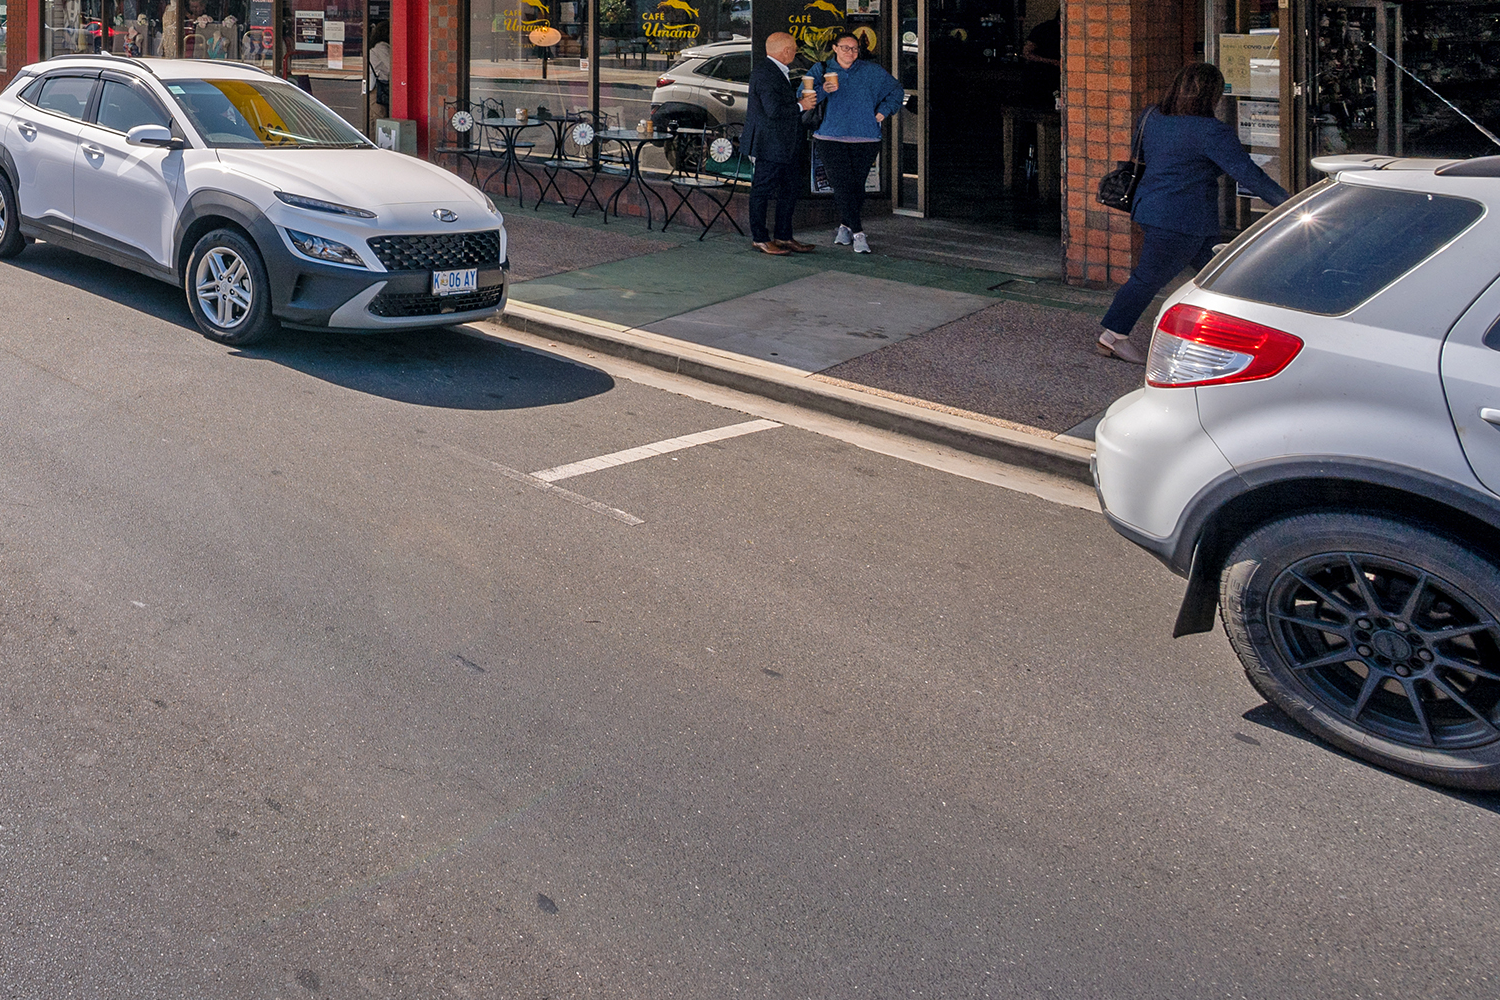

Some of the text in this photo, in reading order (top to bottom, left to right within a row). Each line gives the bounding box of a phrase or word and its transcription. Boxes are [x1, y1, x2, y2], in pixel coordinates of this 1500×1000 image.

[642, 11, 665, 21] CAFÉ
[788, 13, 812, 23] CAFÉ
[642, 21, 700, 38] Umami
[434, 270, 476, 289] K 06 AY
